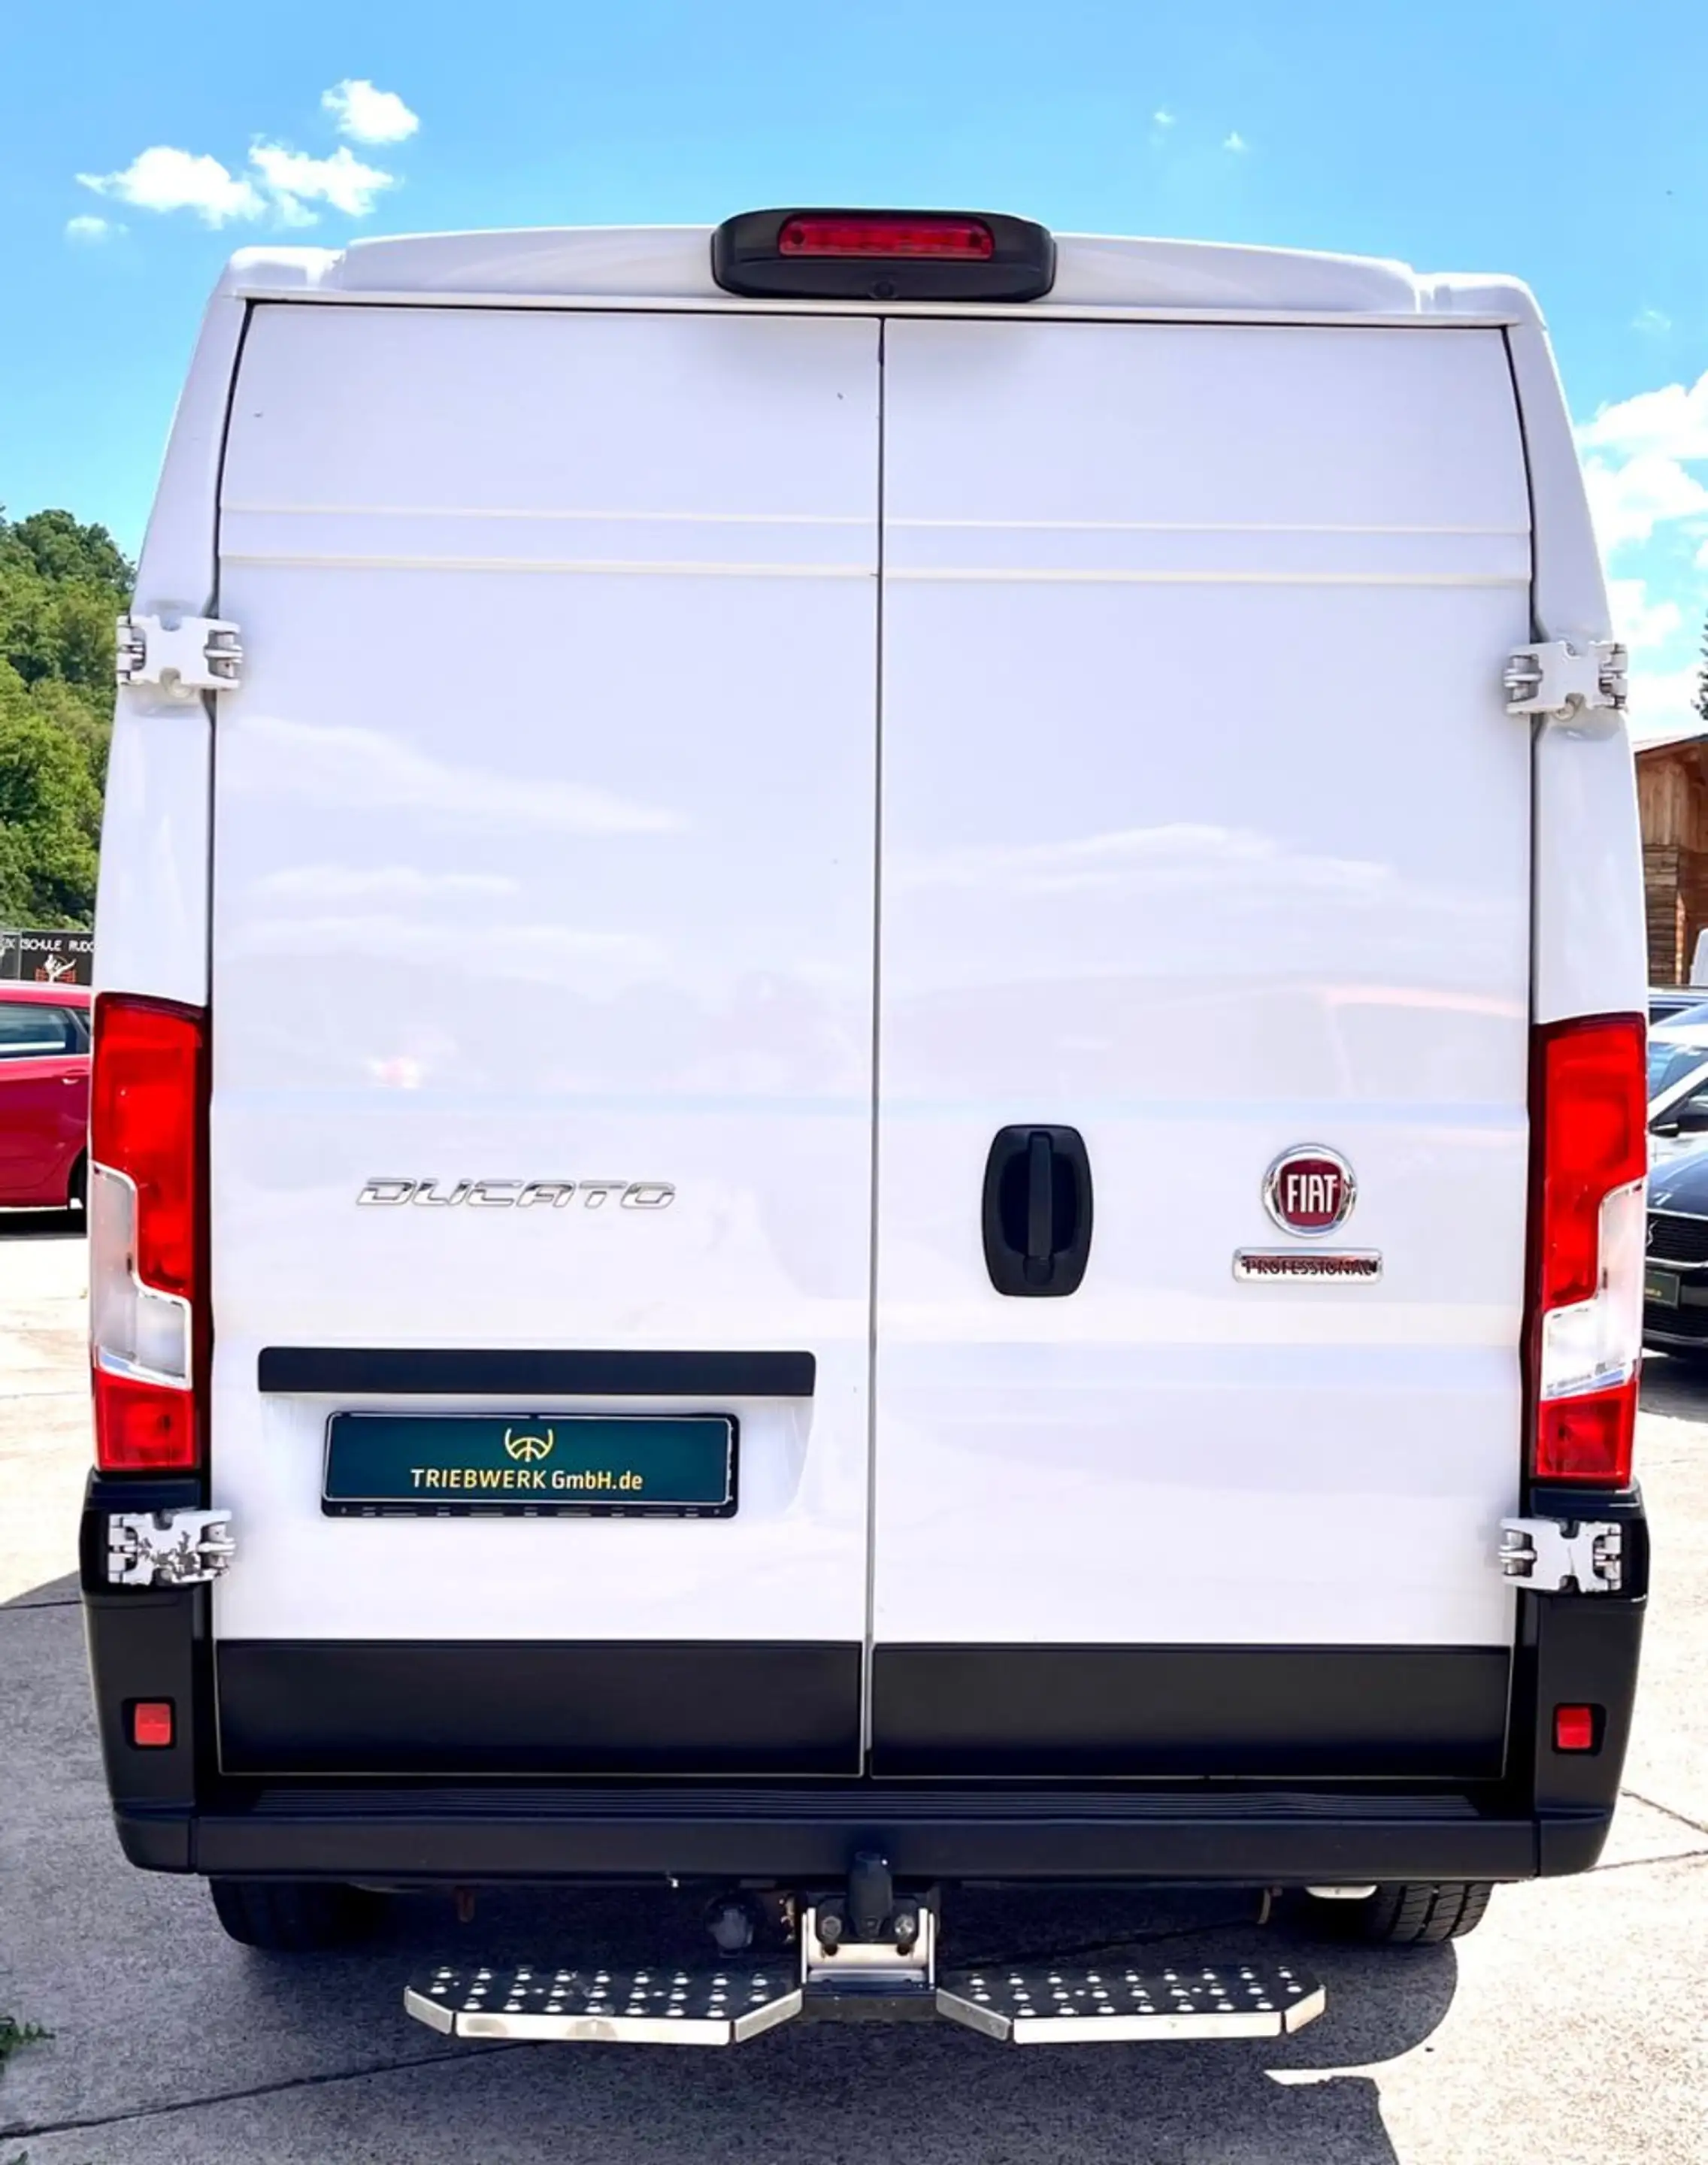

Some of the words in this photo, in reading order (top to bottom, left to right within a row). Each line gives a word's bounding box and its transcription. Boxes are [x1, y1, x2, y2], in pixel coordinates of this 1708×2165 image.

[356, 1178, 675, 1209] DUCATO
[1286, 1173, 1338, 1213] FIAT
[1242, 1258, 1377, 1275] PROFESSIONAL
[410, 1468, 546, 1489] TRIEBWERK
[552, 1470, 644, 1490] GmbH.de
